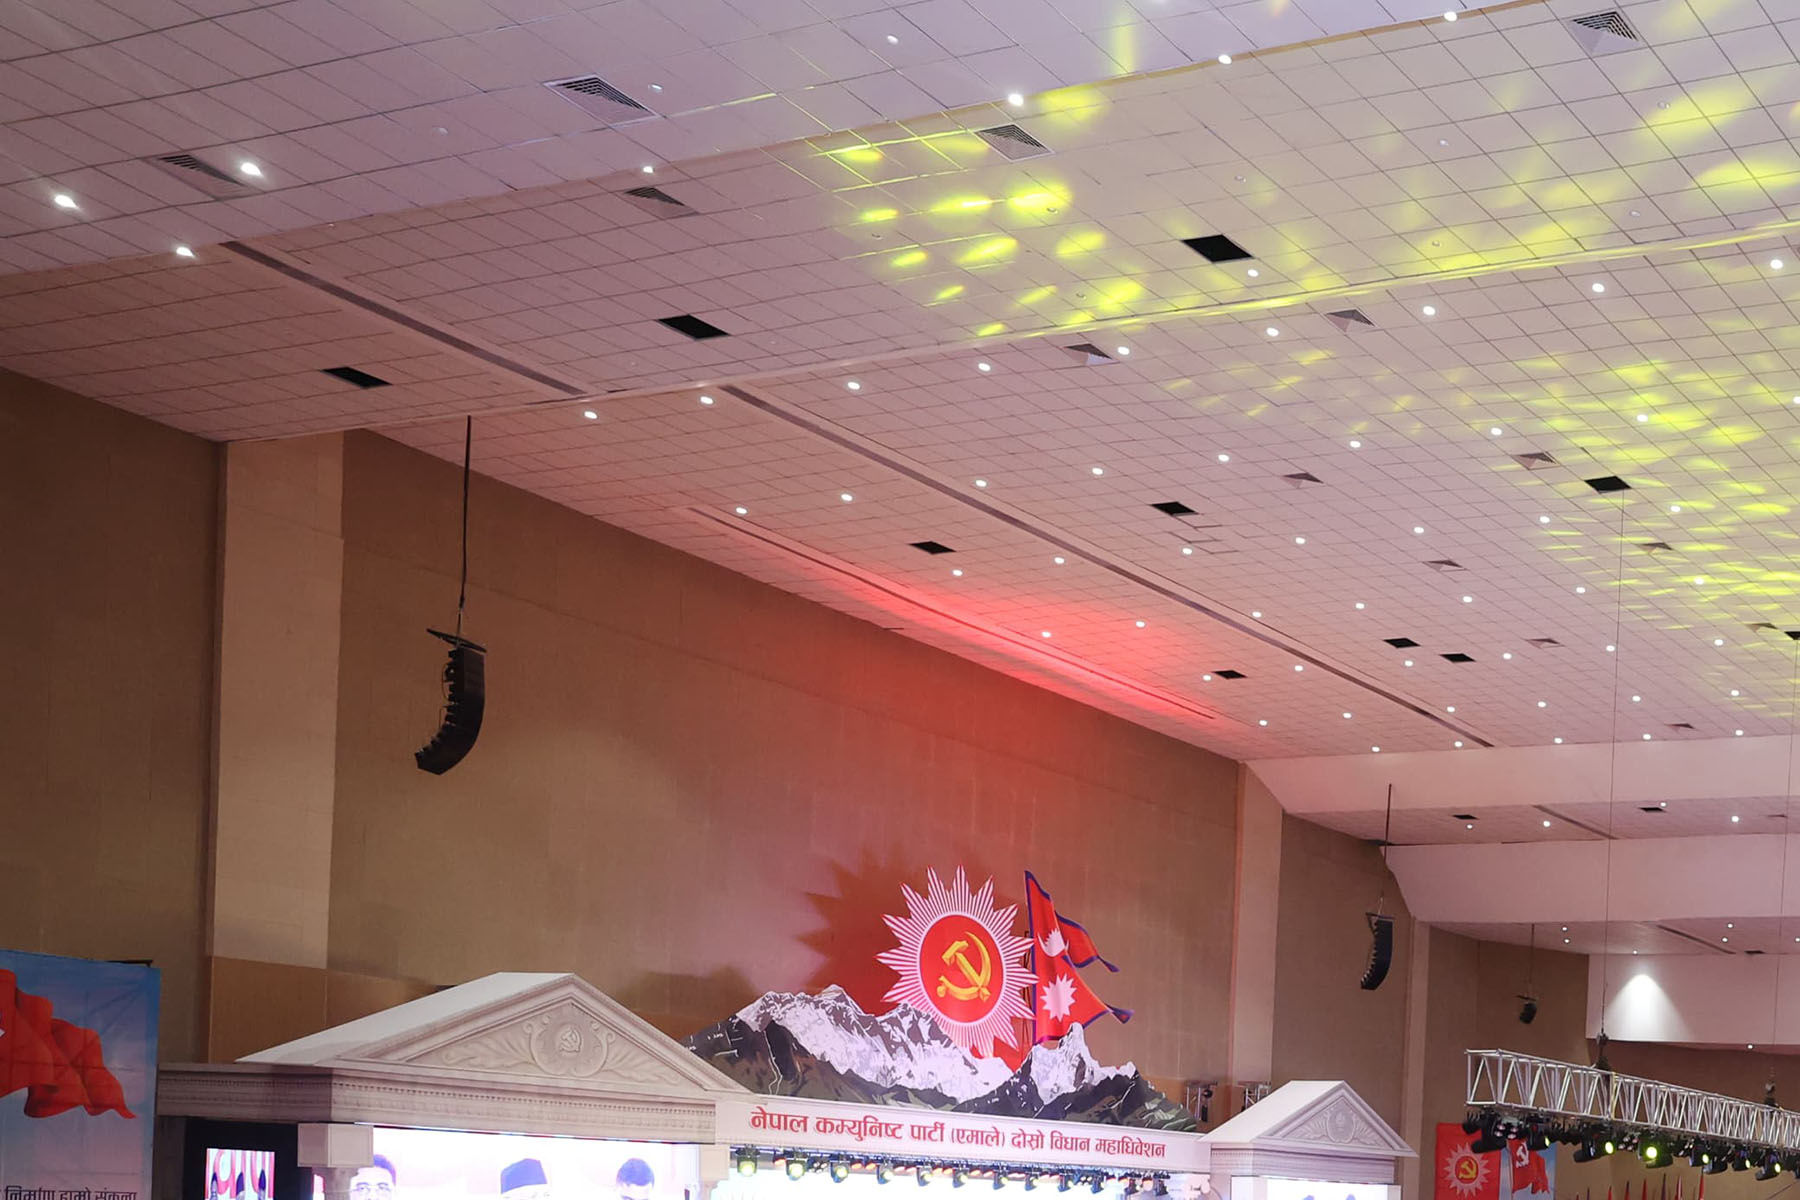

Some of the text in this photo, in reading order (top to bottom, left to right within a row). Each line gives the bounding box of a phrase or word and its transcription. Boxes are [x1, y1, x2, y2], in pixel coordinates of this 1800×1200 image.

[750, 1106, 1166, 1158] नेपाल कम्युनिष्ट पार्टी (एमाले) दोस्रो विधान महाधिवेशन
